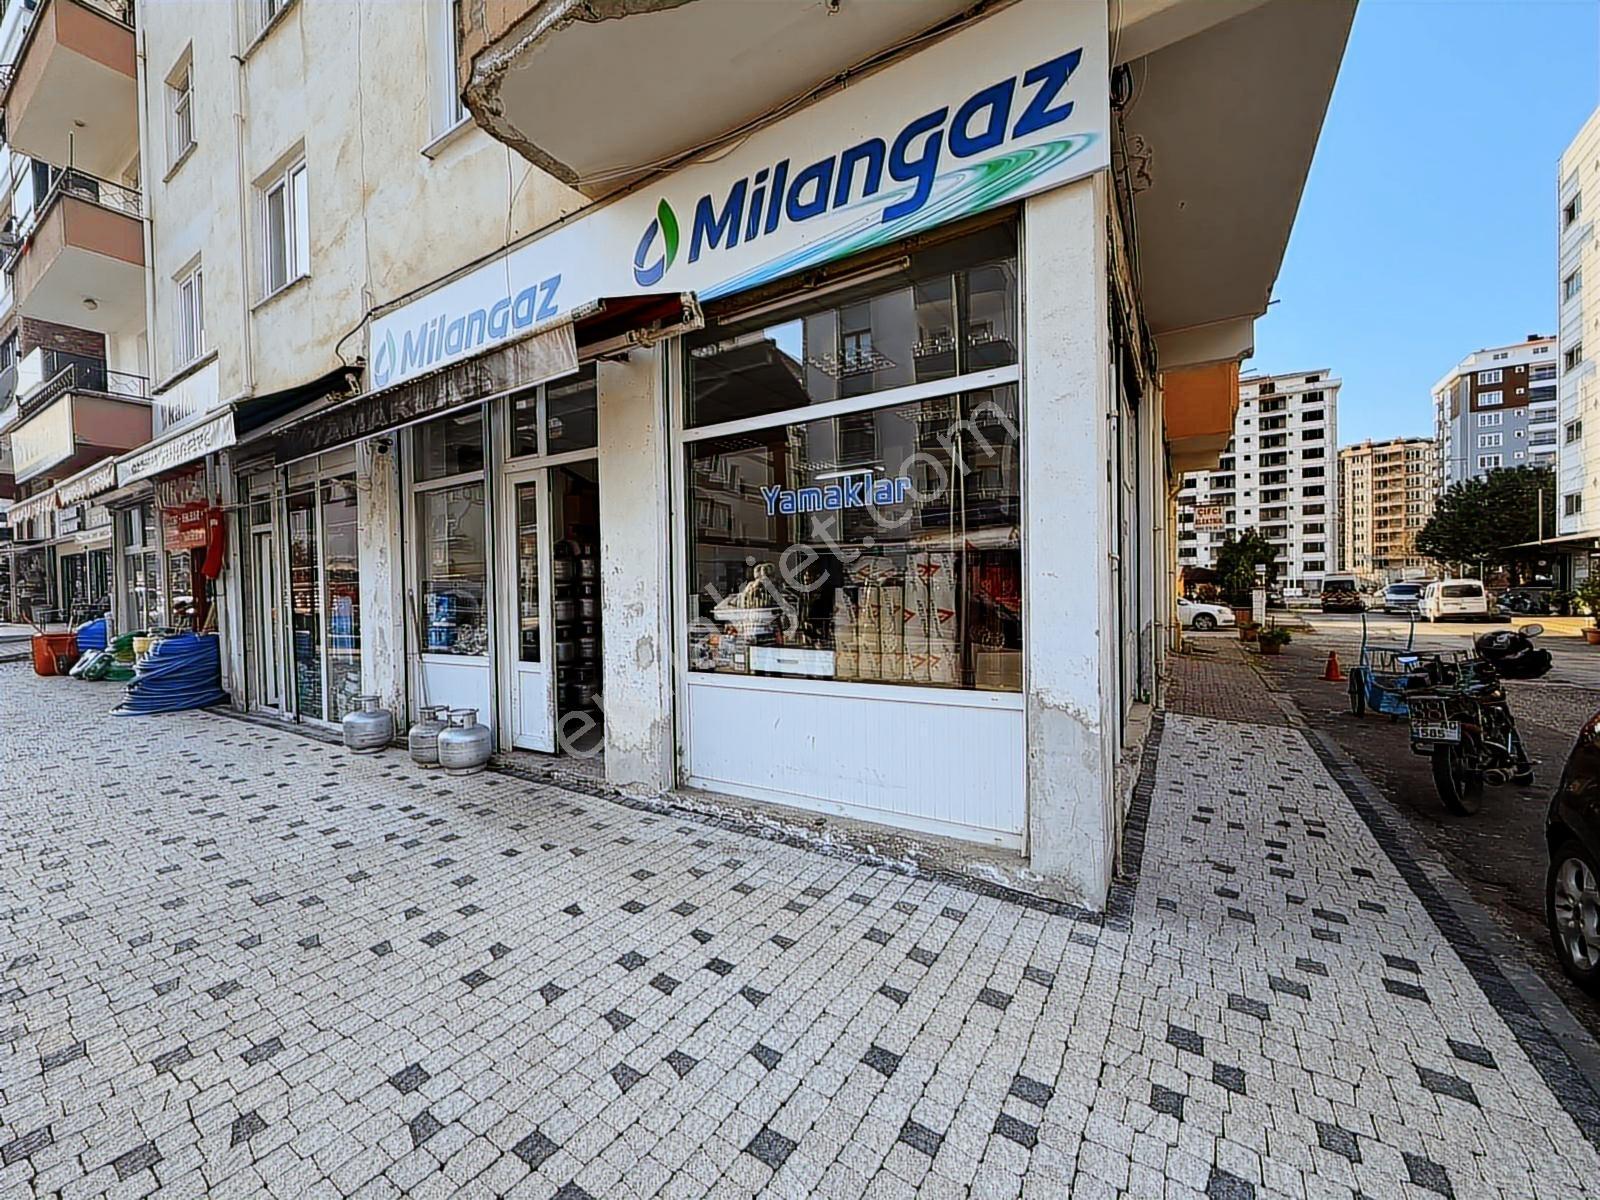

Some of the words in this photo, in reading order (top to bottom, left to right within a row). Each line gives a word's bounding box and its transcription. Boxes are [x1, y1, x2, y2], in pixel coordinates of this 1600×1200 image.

[688, 47, 1083, 263] Milangaz
[400, 273, 562, 374] Milangaz
[760, 472, 913, 516] Yamaklar
